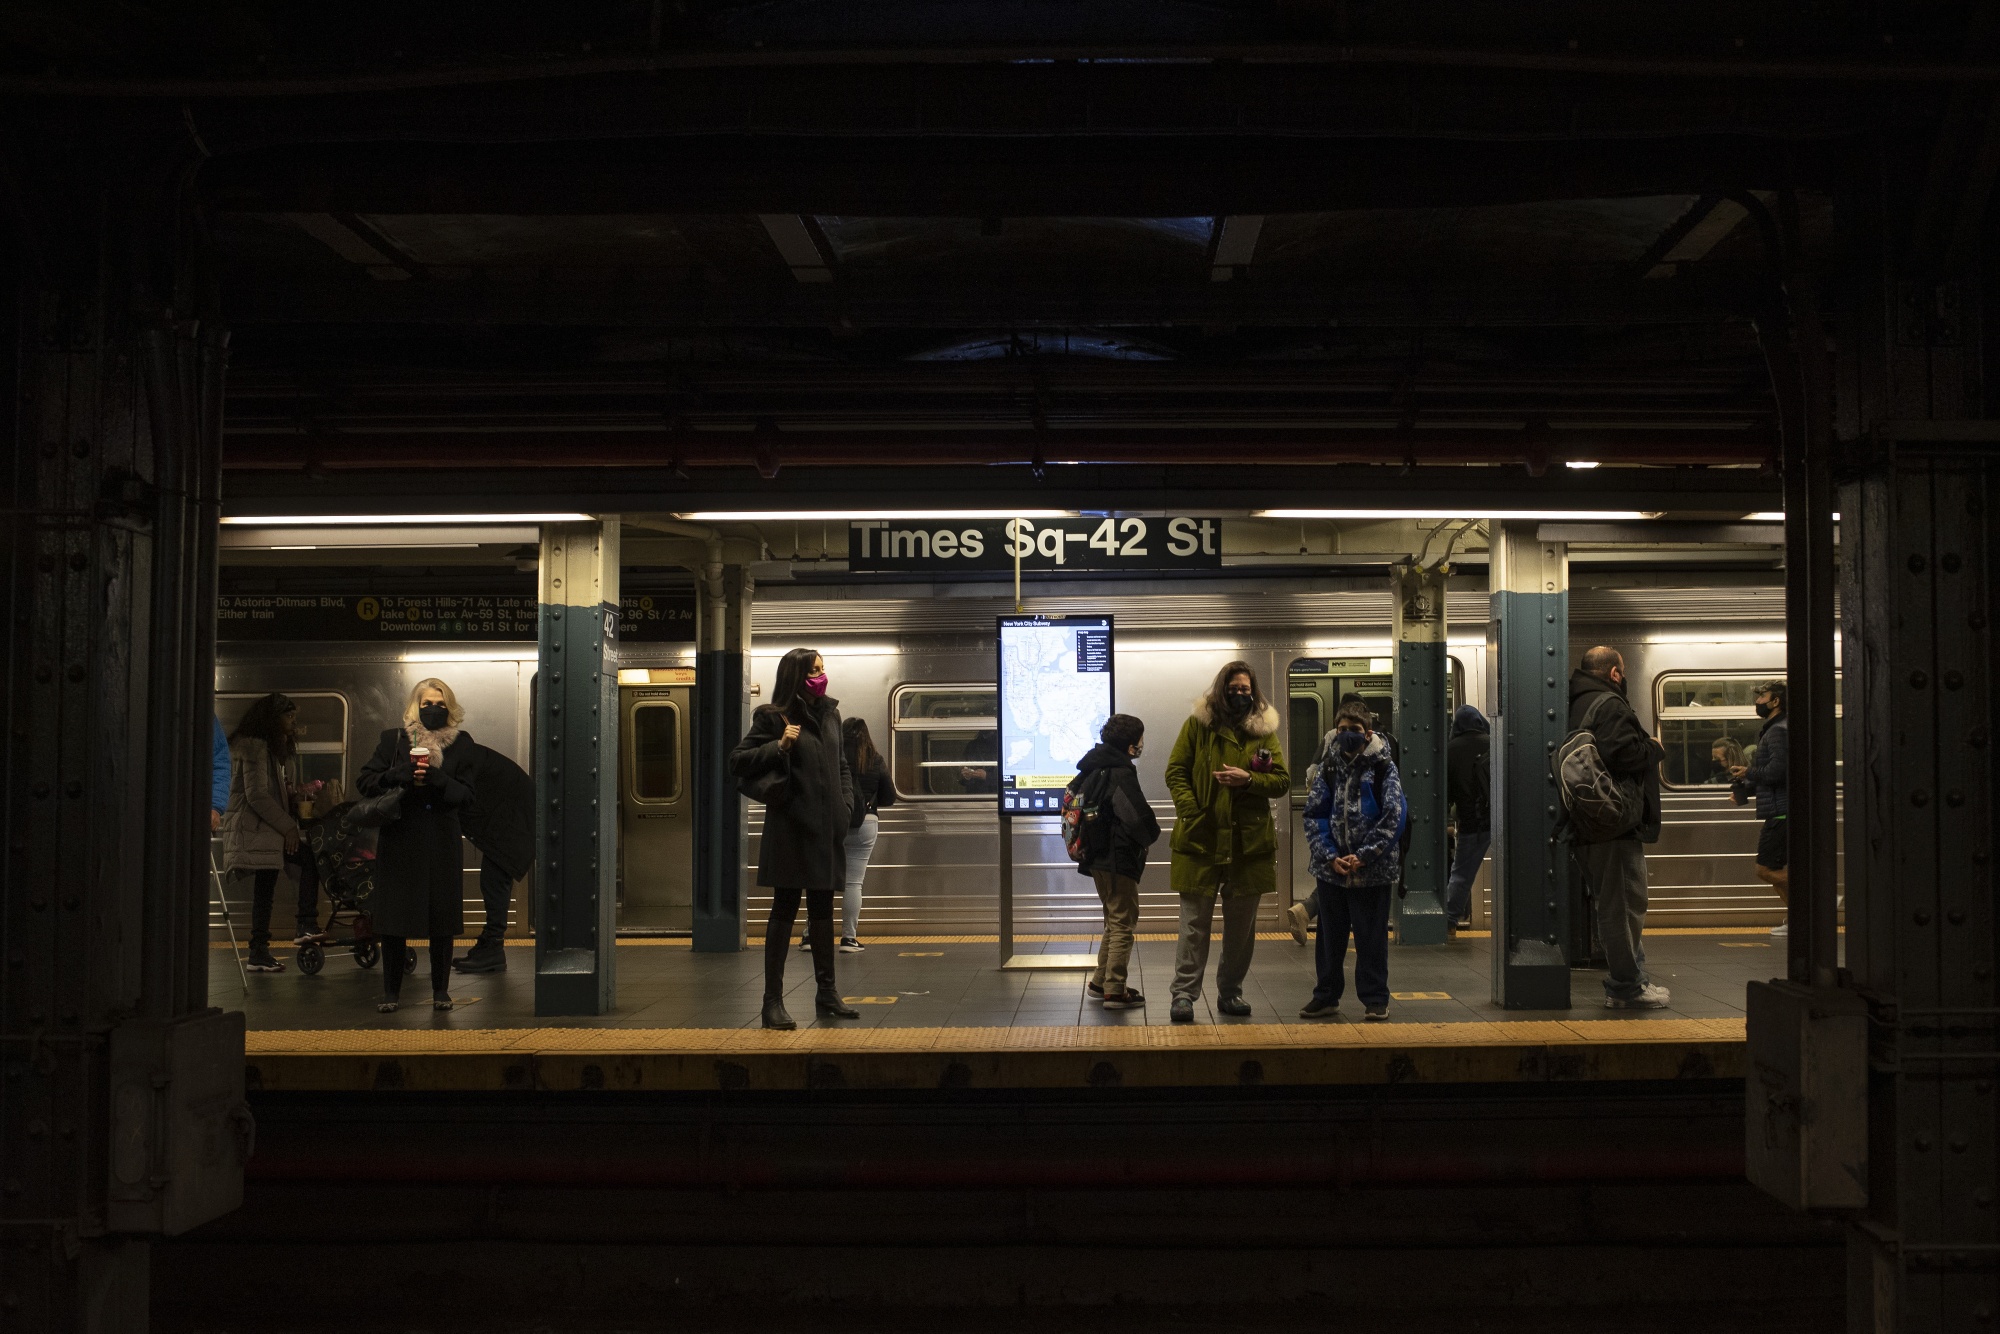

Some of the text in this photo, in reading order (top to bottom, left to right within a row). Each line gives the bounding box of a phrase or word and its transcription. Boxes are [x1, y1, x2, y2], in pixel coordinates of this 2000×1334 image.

[851, 517, 1216, 565] Times Sq-42 St
[217, 597, 230, 607] To
[234, 597, 317, 607] Astoria-Ditmars
[380, 597, 394, 607] To
[397, 597, 432, 607] Forest
[435, 597, 474, 607] Hills-71
[477, 597, 493, 607] Av.
[496, 597, 520, 607] Late
[217, 608, 275, 619] Either train
[380, 609, 405, 619] take
[422, 609, 434, 619] to
[437, 609, 457, 619] Lex
[460, 609, 494, 619] Av-59
[497, 609, 512, 620] St,
[628, 609, 643, 620] 96
[679, 609, 693, 620] Av
[380, 621, 436, 631] Downtown
[467, 621, 479, 631] to
[482, 621, 495, 631] 51
[498, 621, 511, 631] St
[514, 621, 529, 631] for
[603, 612, 614, 638] 42
